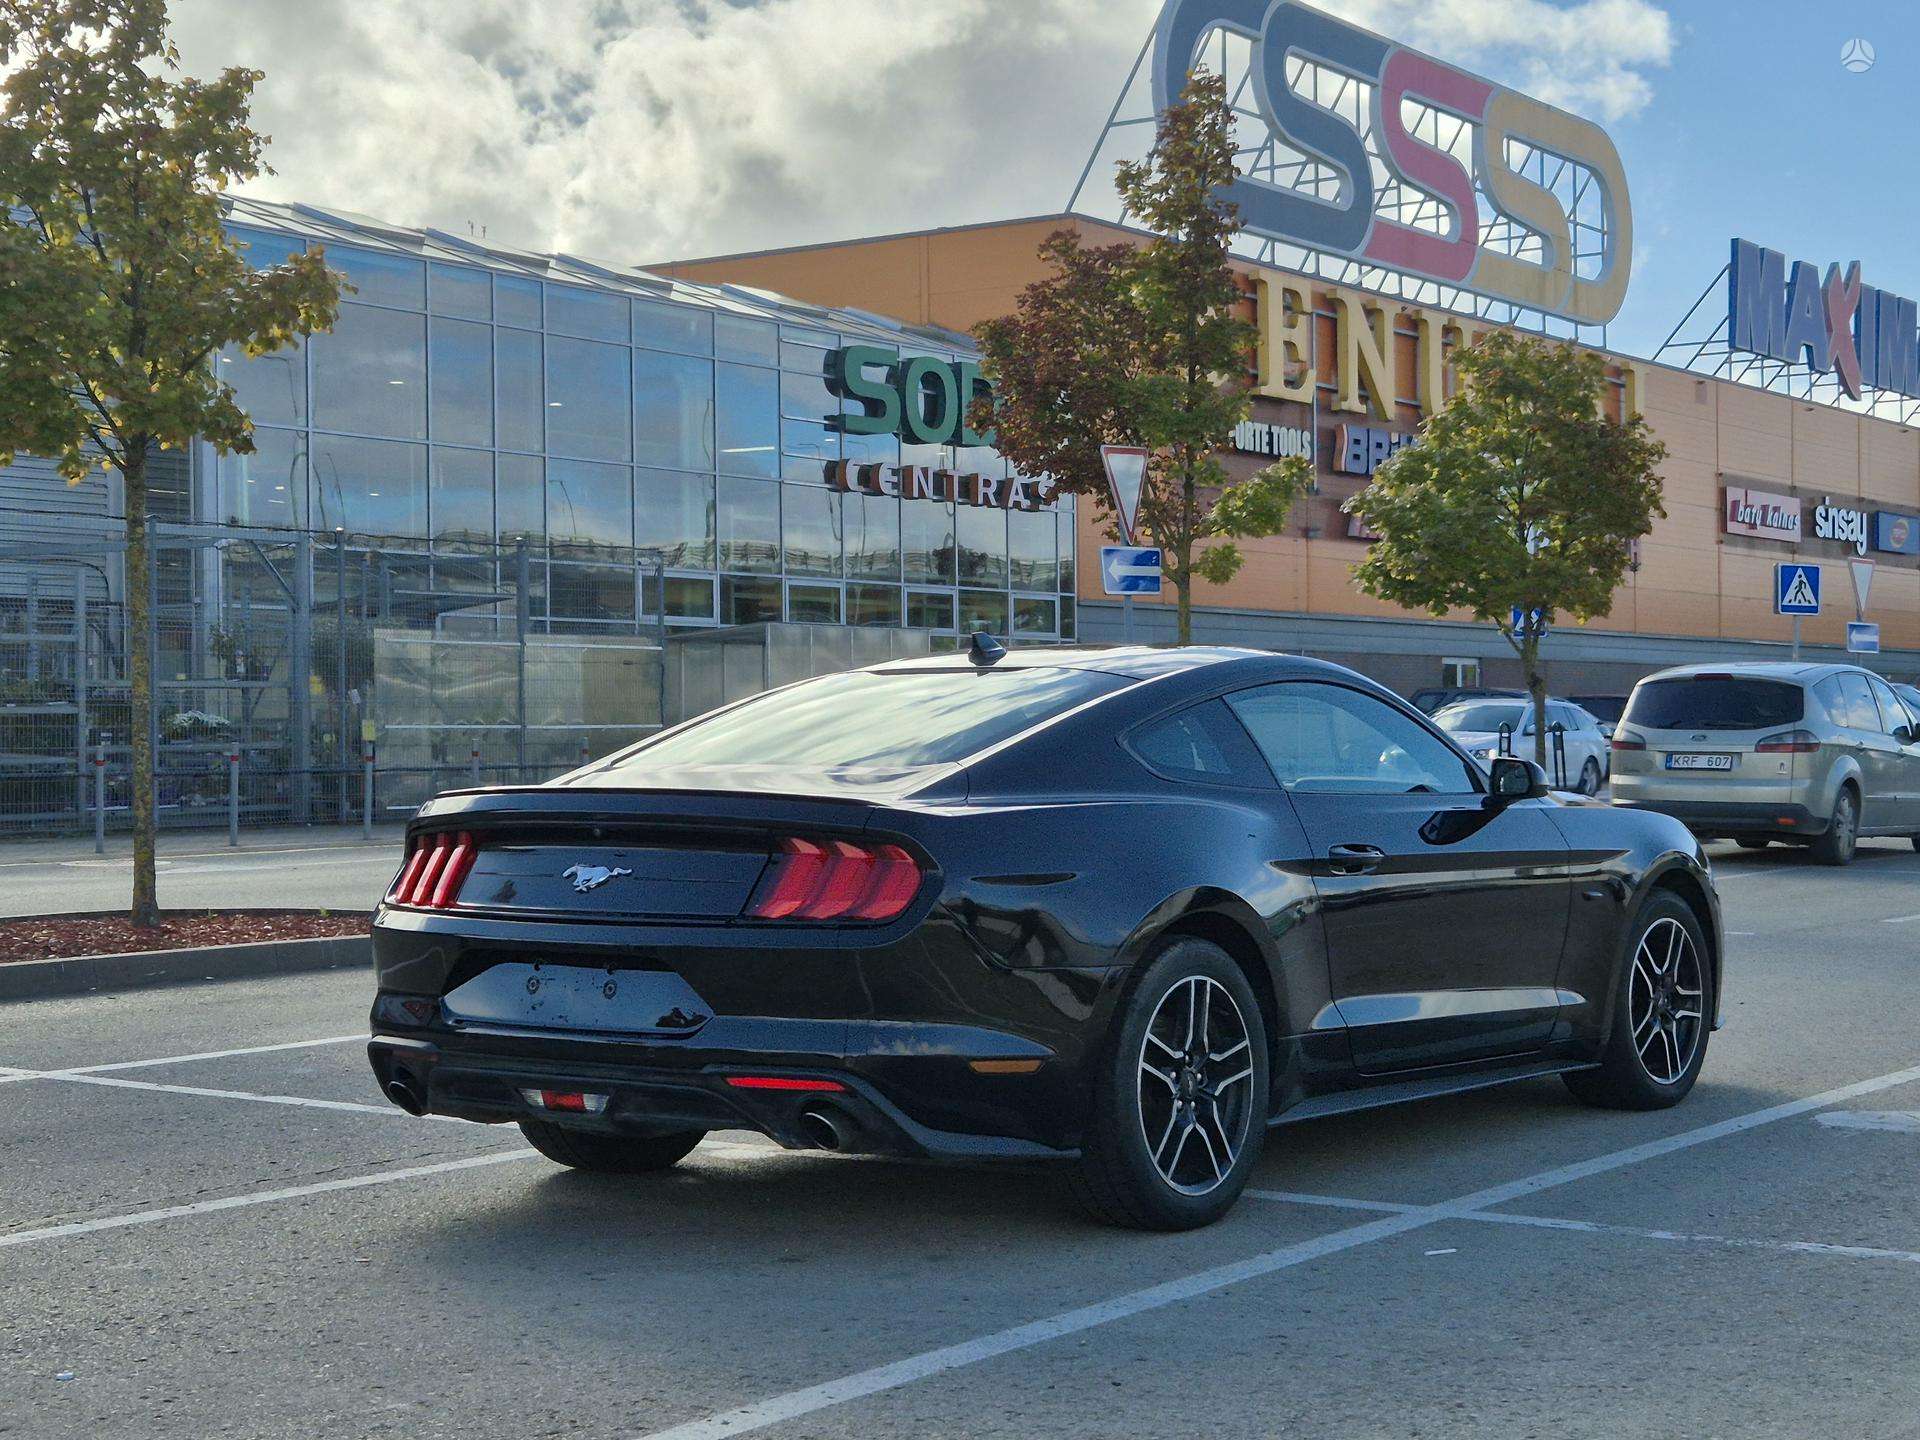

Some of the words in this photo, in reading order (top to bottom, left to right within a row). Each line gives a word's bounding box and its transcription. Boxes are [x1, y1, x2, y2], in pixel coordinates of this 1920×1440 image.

[1729, 238, 1920, 401] MAXIM
[1673, 755, 1698, 766] KRF
[1707, 756, 1730, 767] 607
